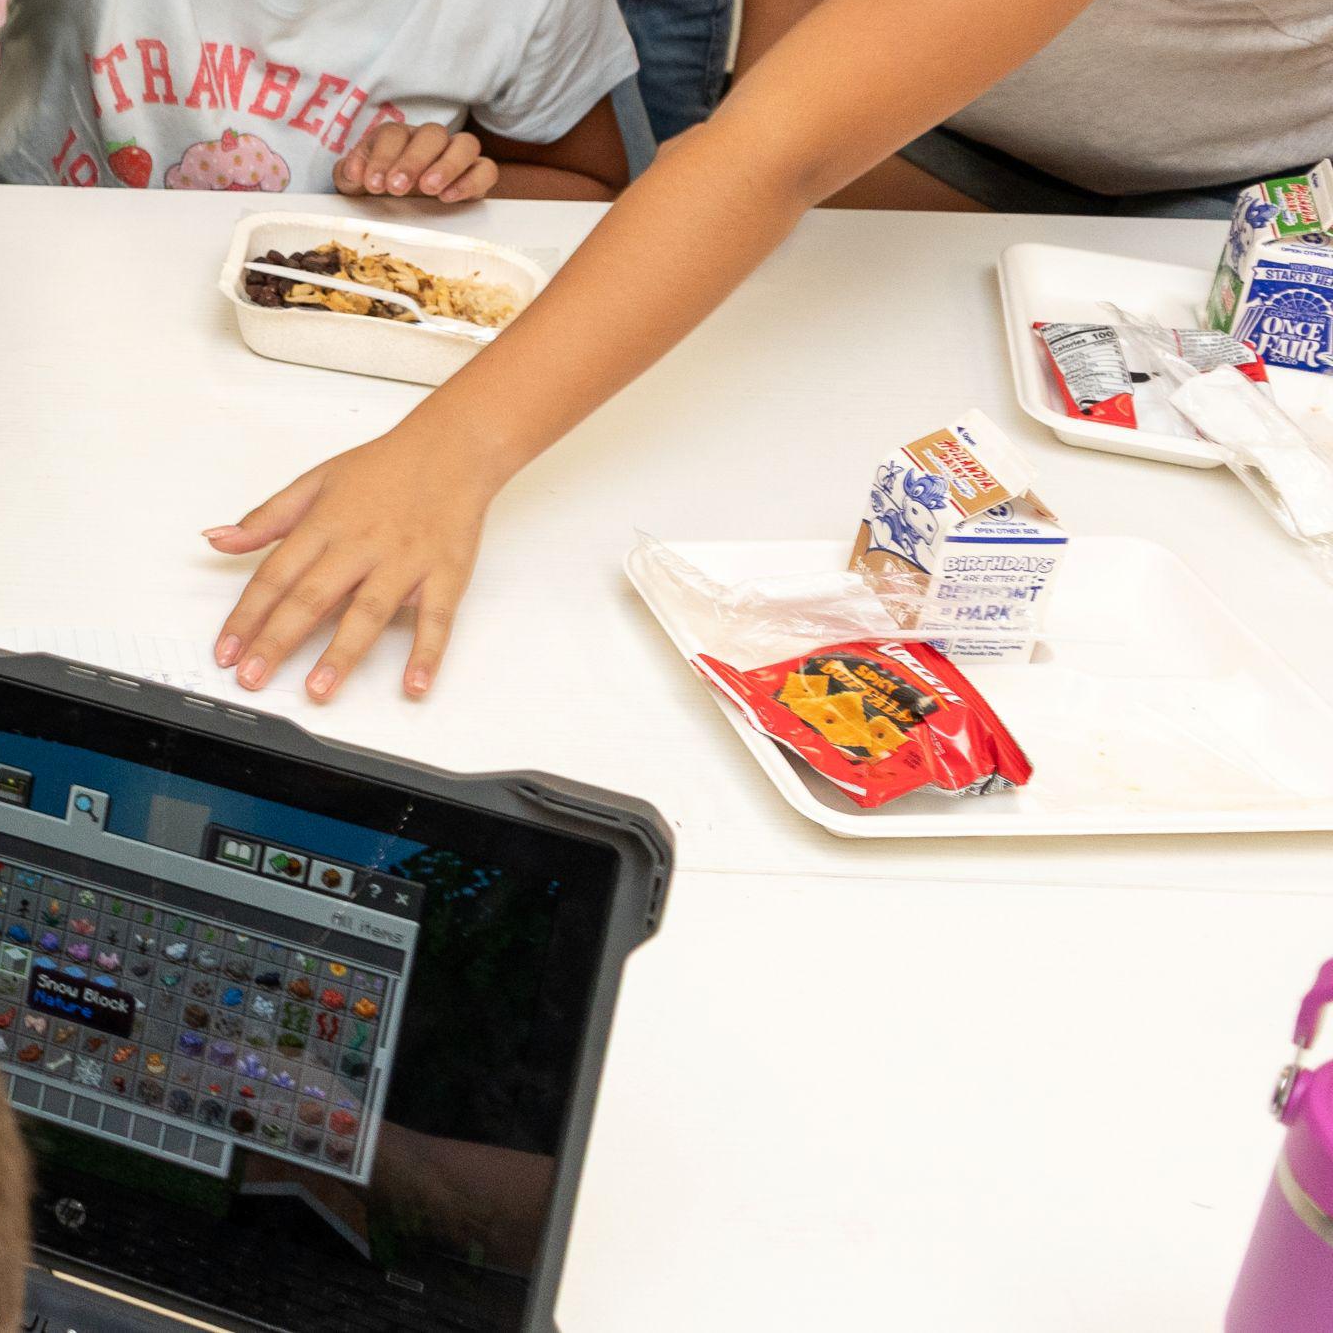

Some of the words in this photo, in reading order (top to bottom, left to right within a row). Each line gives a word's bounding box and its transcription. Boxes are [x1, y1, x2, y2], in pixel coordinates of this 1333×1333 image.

[1265, 269, 1314, 283] STARTS
[1262, 317, 1325, 340] ONCE
[1052, 337, 1088, 356] Calories
[1092, 329, 1115, 341] 100
[1257, 333, 1321, 367] FAIR
[937, 440, 996, 490] HOLLANDIA
[938, 453, 970, 478] DAIRY
[962, 574, 978, 582] ARE
[982, 574, 1016, 582] BETTER
[955, 605, 1014, 621] PARK
[853, 665, 900, 694] SPICY
[359, 920, 405, 943] items
[34, 989, 93, 1018] Nature
[37, 973, 80, 998] Snow
[83, 987, 130, 1013] Block
